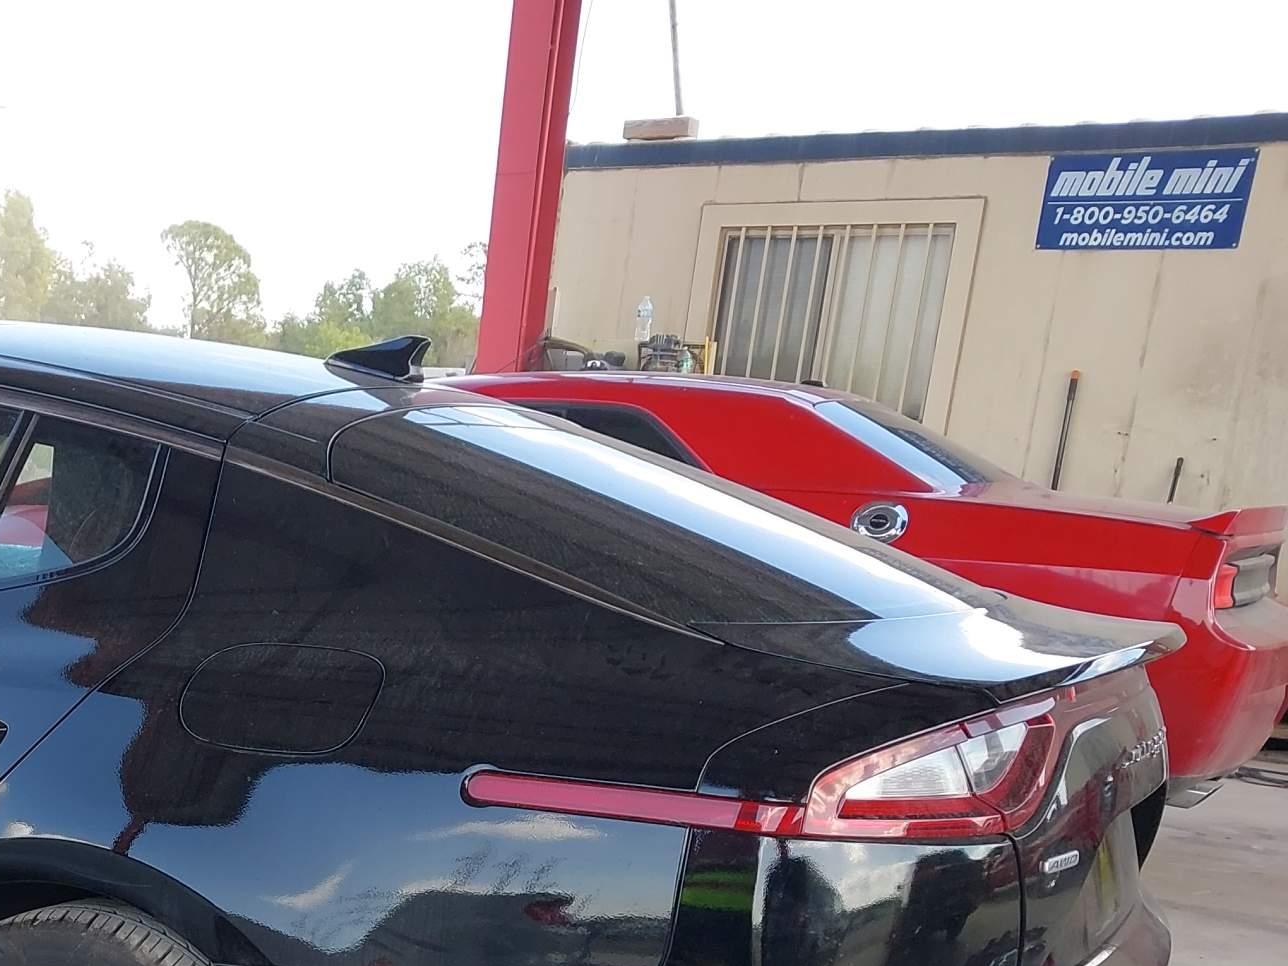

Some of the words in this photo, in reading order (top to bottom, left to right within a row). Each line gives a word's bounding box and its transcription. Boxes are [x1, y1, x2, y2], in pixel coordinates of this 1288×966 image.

[1050, 156, 1163, 196] mobile
[1162, 158, 1250, 195] mini
[1053, 204, 1230, 225] 1-800-950-6464
[1059, 228, 1214, 246] mobilemini.com
